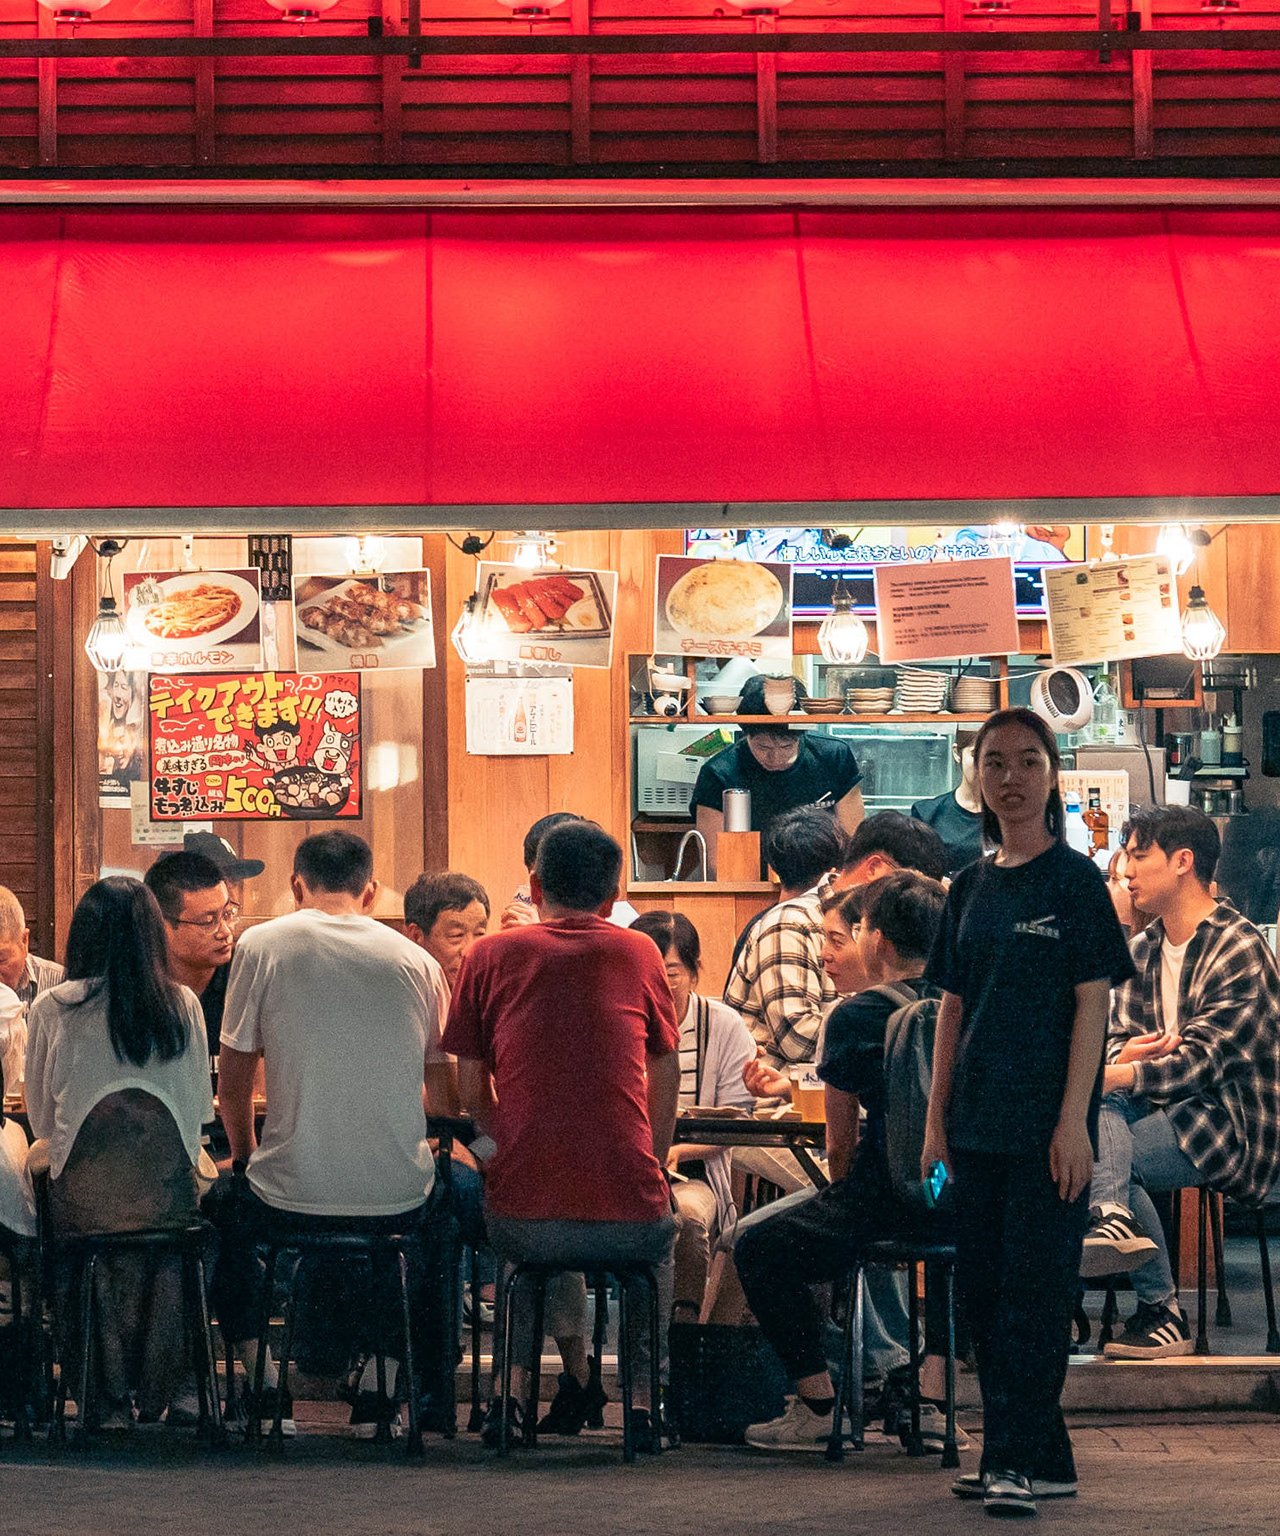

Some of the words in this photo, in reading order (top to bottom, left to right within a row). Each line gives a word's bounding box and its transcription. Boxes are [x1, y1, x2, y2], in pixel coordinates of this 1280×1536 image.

[149, 671, 285, 718] テイクアウト
[154, 776, 199, 796] 牛すじ
[154, 795, 225, 816] もつ煮込み
